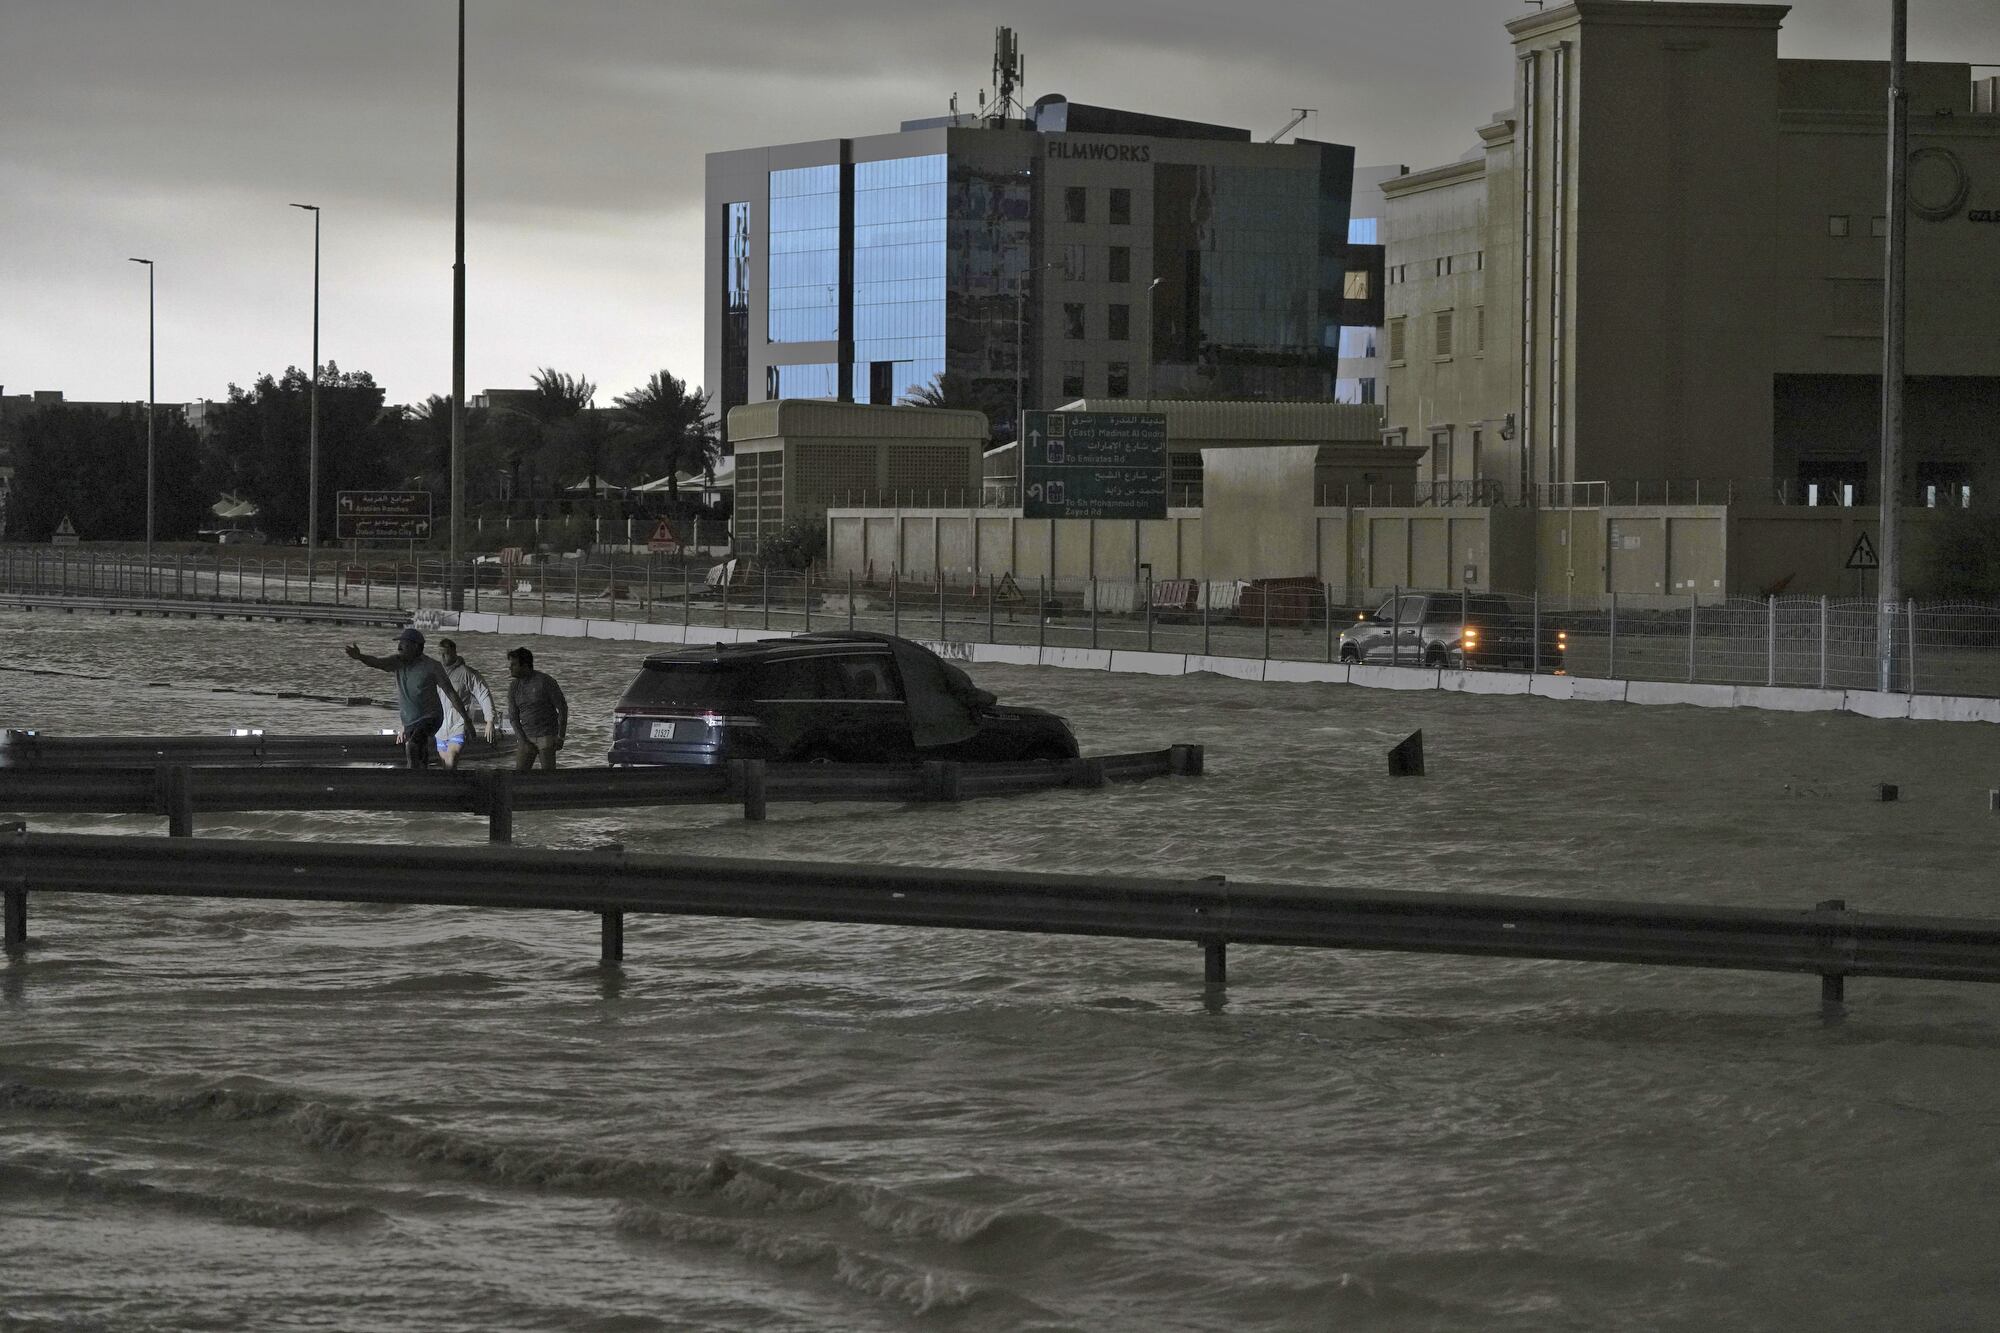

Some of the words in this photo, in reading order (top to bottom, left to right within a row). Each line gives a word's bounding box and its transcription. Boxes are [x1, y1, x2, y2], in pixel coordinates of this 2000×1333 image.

[1049, 141, 1150, 162] FILMWORKS
[1069, 429, 1095, 439] (East)
[1098, 429, 1132, 438] Madinat
[1132, 430, 1140, 438] Al
[1066, 454, 1076, 463] To
[1077, 454, 1112, 463] Emirates
[1114, 454, 1126, 463] Rd
[1066, 498, 1075, 507] To
[1136, 498, 1149, 507] bin
[1090, 507, 1102, 516] Rd
[654, 729, 670, 738] 21527
